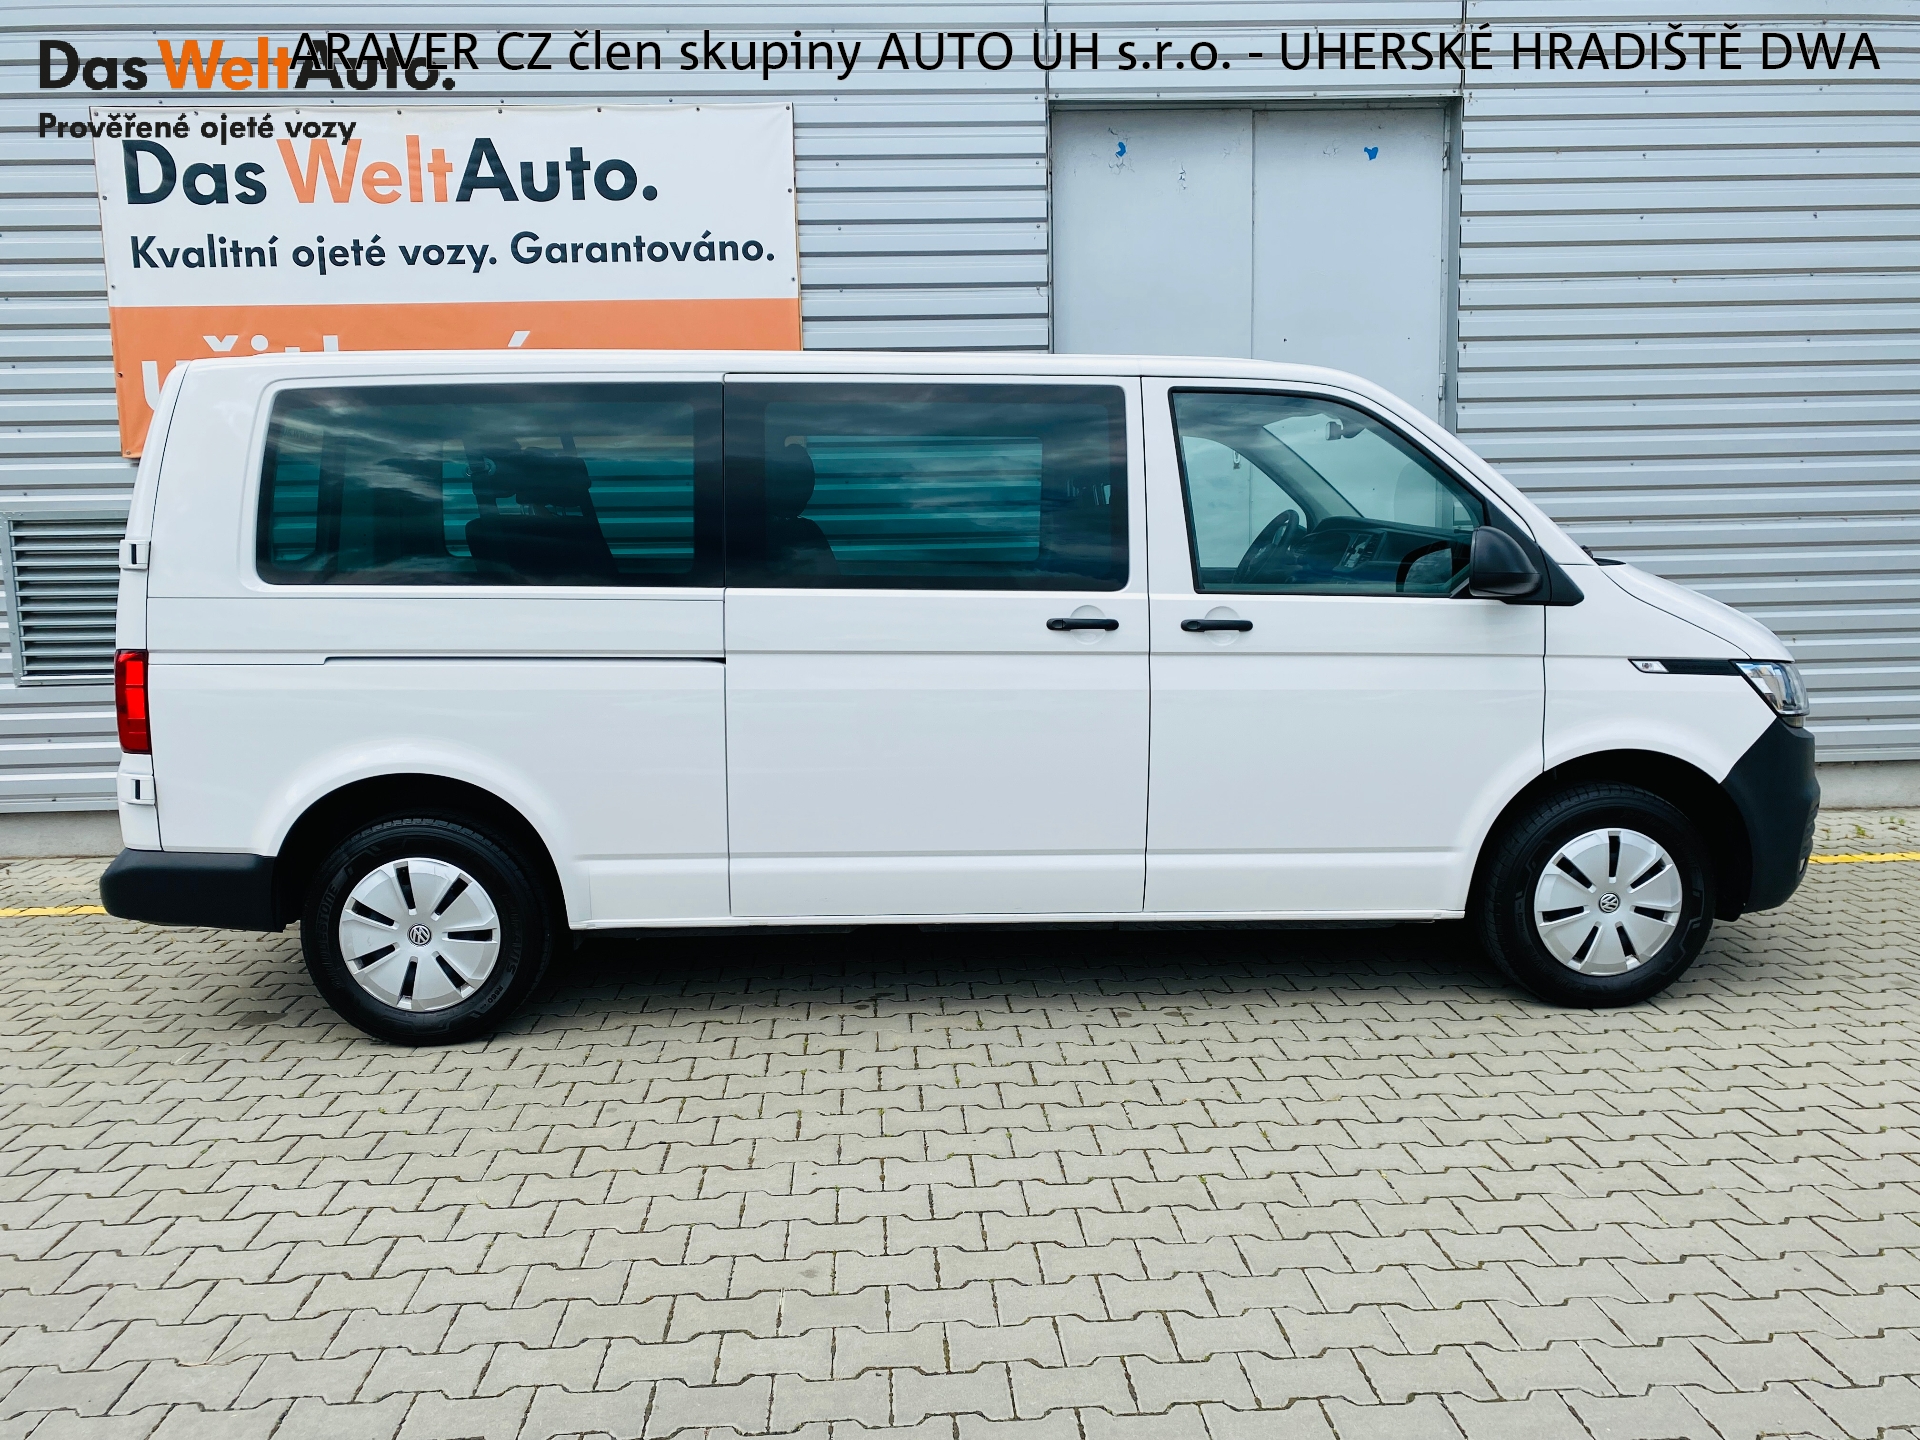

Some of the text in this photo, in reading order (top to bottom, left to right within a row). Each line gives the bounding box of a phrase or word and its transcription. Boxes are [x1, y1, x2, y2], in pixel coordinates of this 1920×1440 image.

[122, 134, 658, 206] Das WeltAuto.
[130, 230, 775, 275] Kvalitní ojeté vozy. Garantováno.
